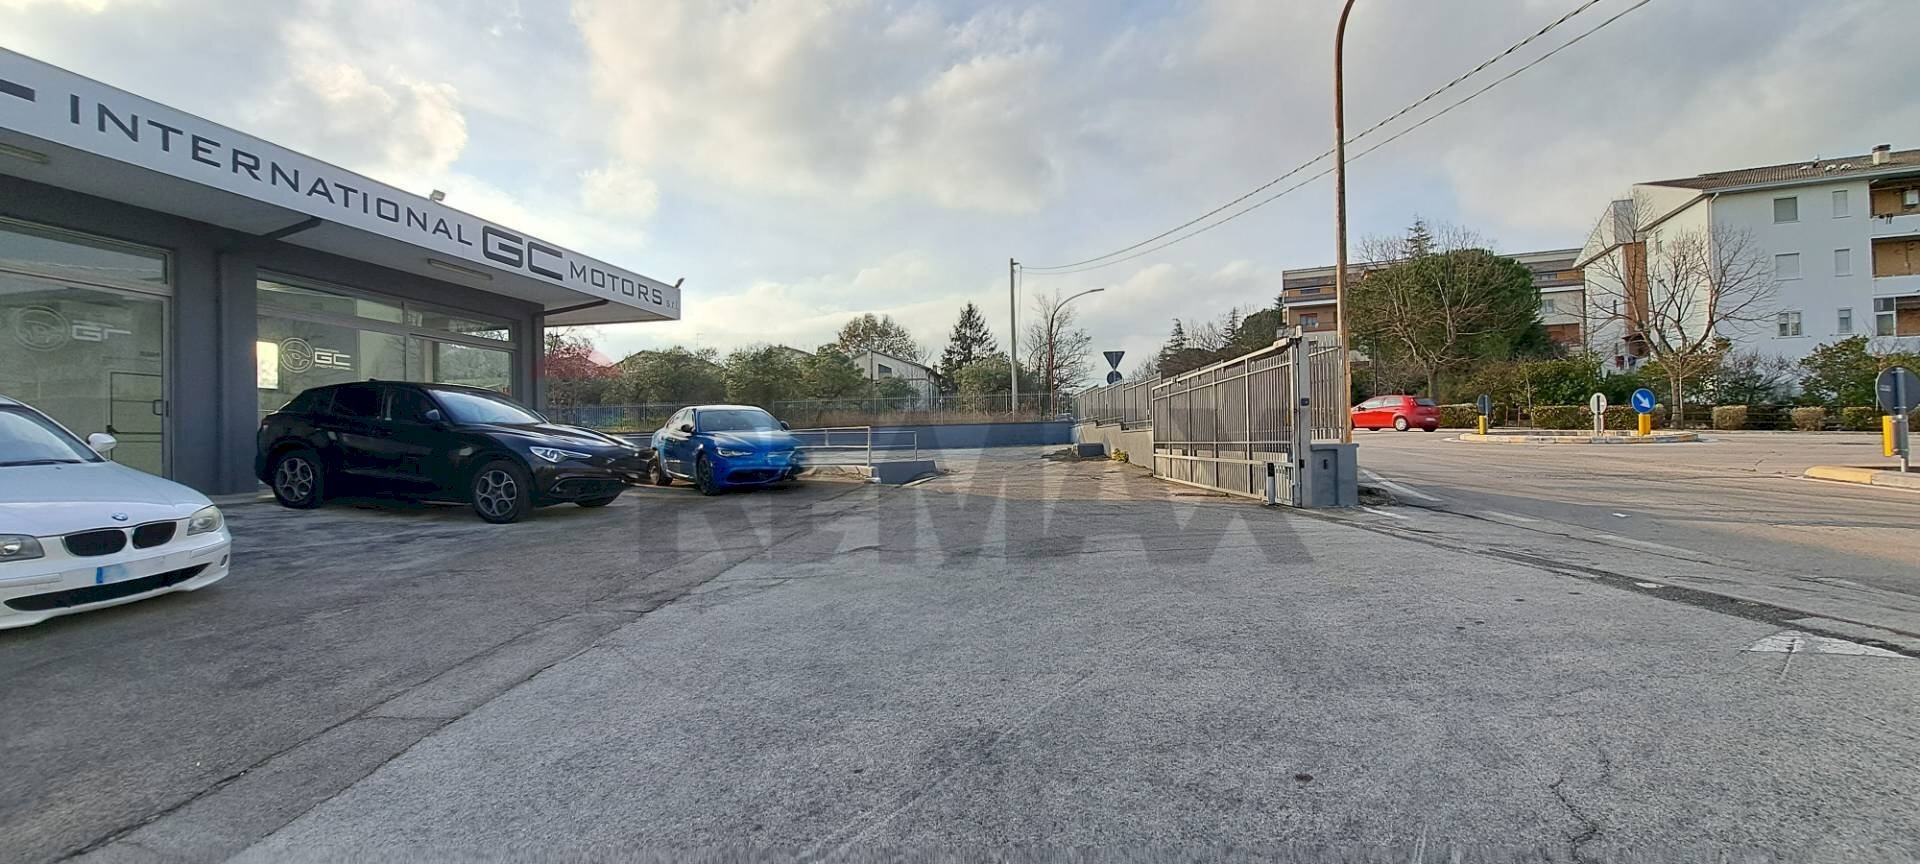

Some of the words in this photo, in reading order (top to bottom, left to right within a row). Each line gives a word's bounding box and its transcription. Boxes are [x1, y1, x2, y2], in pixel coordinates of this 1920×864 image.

[70, 94, 472, 247] INTERNATIONAL
[483, 226, 563, 281] GC
[570, 261, 662, 305] MOTORS
[314, 351, 351, 366] GC
